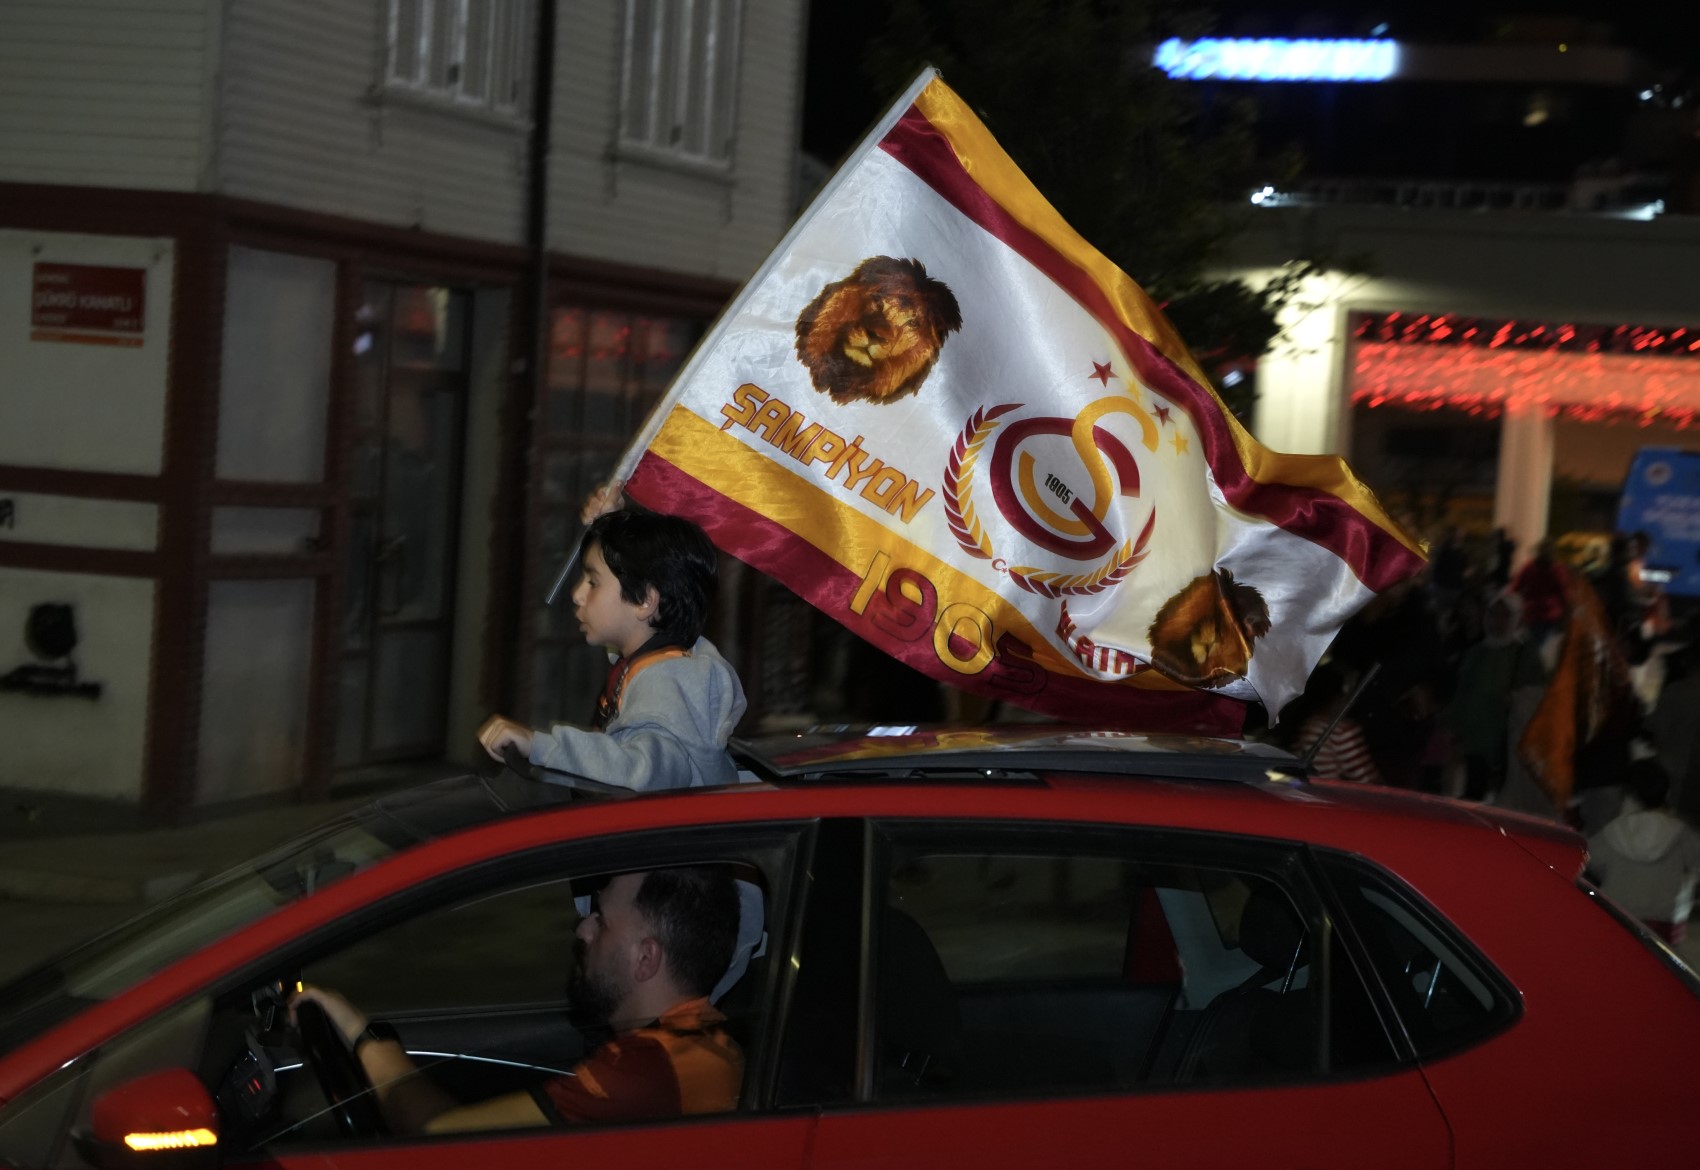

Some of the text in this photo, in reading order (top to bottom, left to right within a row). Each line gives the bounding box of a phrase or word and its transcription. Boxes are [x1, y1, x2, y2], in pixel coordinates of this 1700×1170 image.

[719, 382, 936, 525] ŞAMPİYON
[1044, 473, 1073, 505] 1905
[850, 550, 1048, 695] 1905
